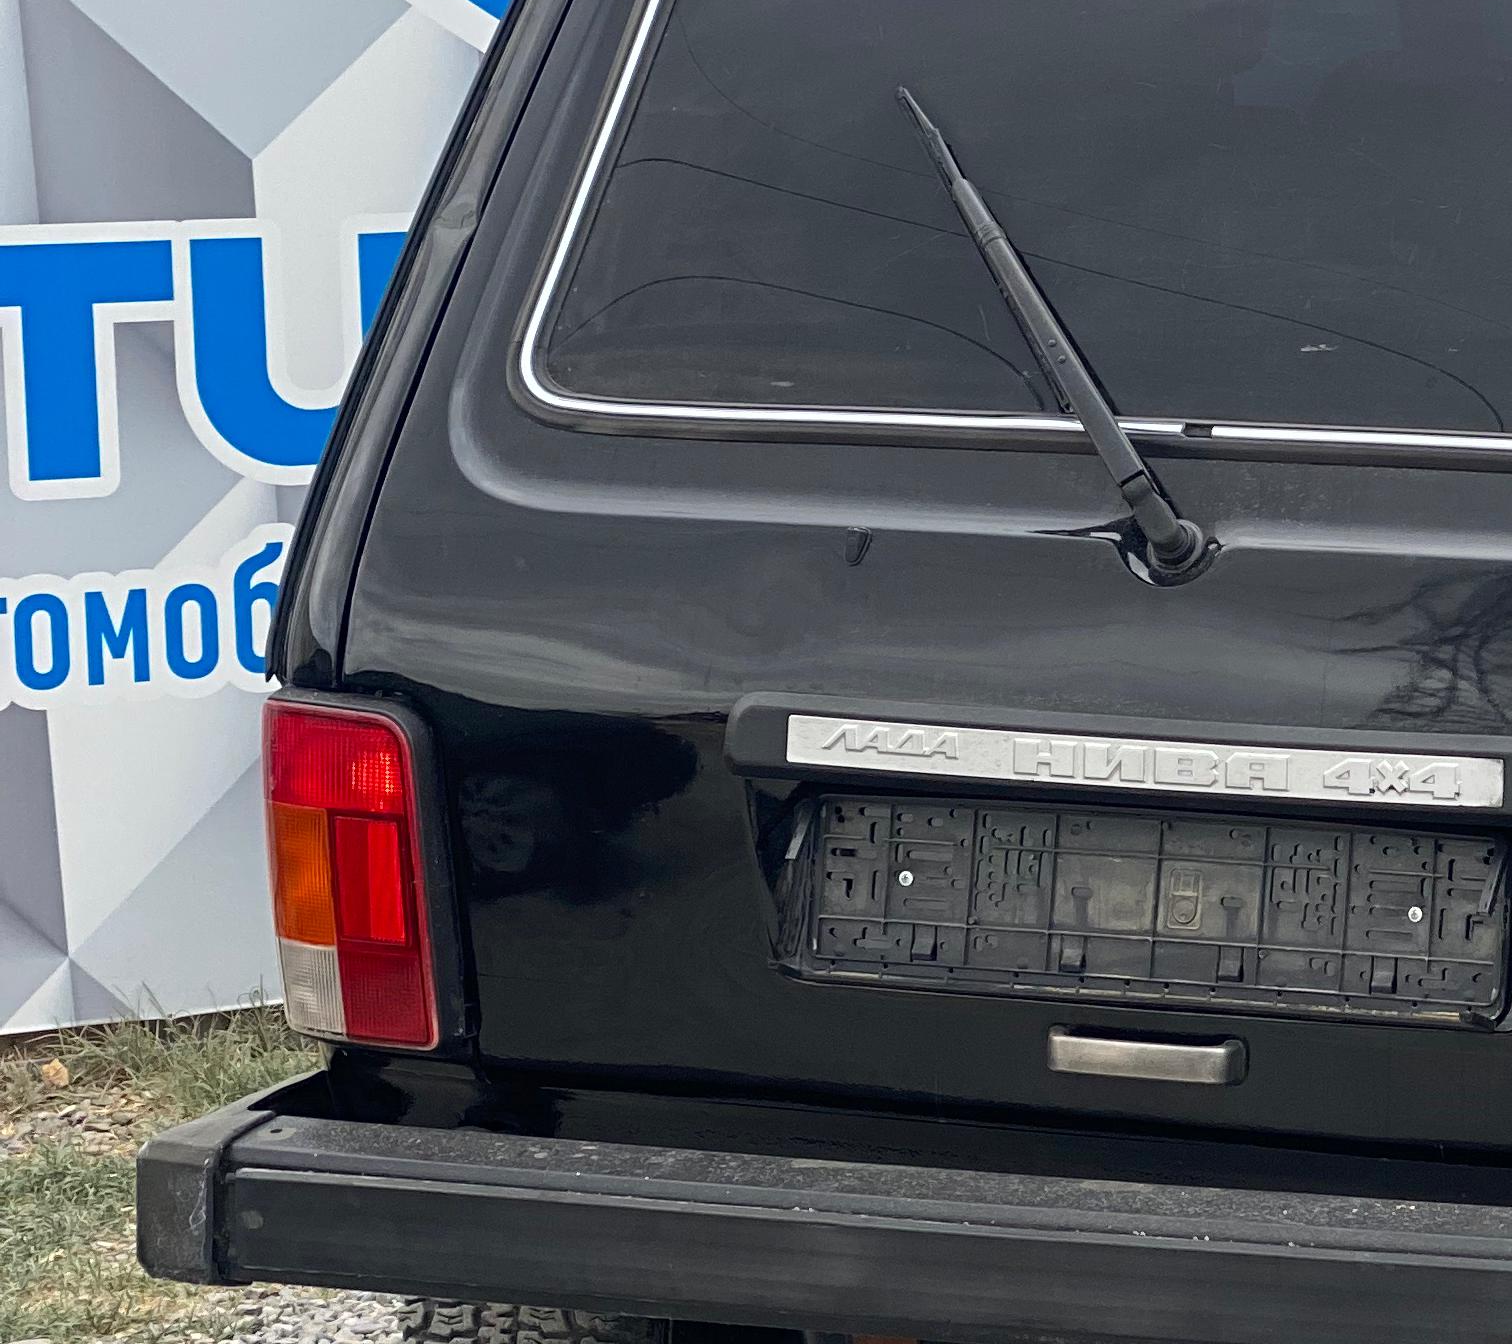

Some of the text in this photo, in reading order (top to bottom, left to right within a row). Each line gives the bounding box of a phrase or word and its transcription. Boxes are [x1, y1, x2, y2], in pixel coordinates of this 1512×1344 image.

[0, 542, 282, 690] омоб
[821, 722, 960, 761] ЛАДА
[1011, 737, 1291, 792] НИВА
